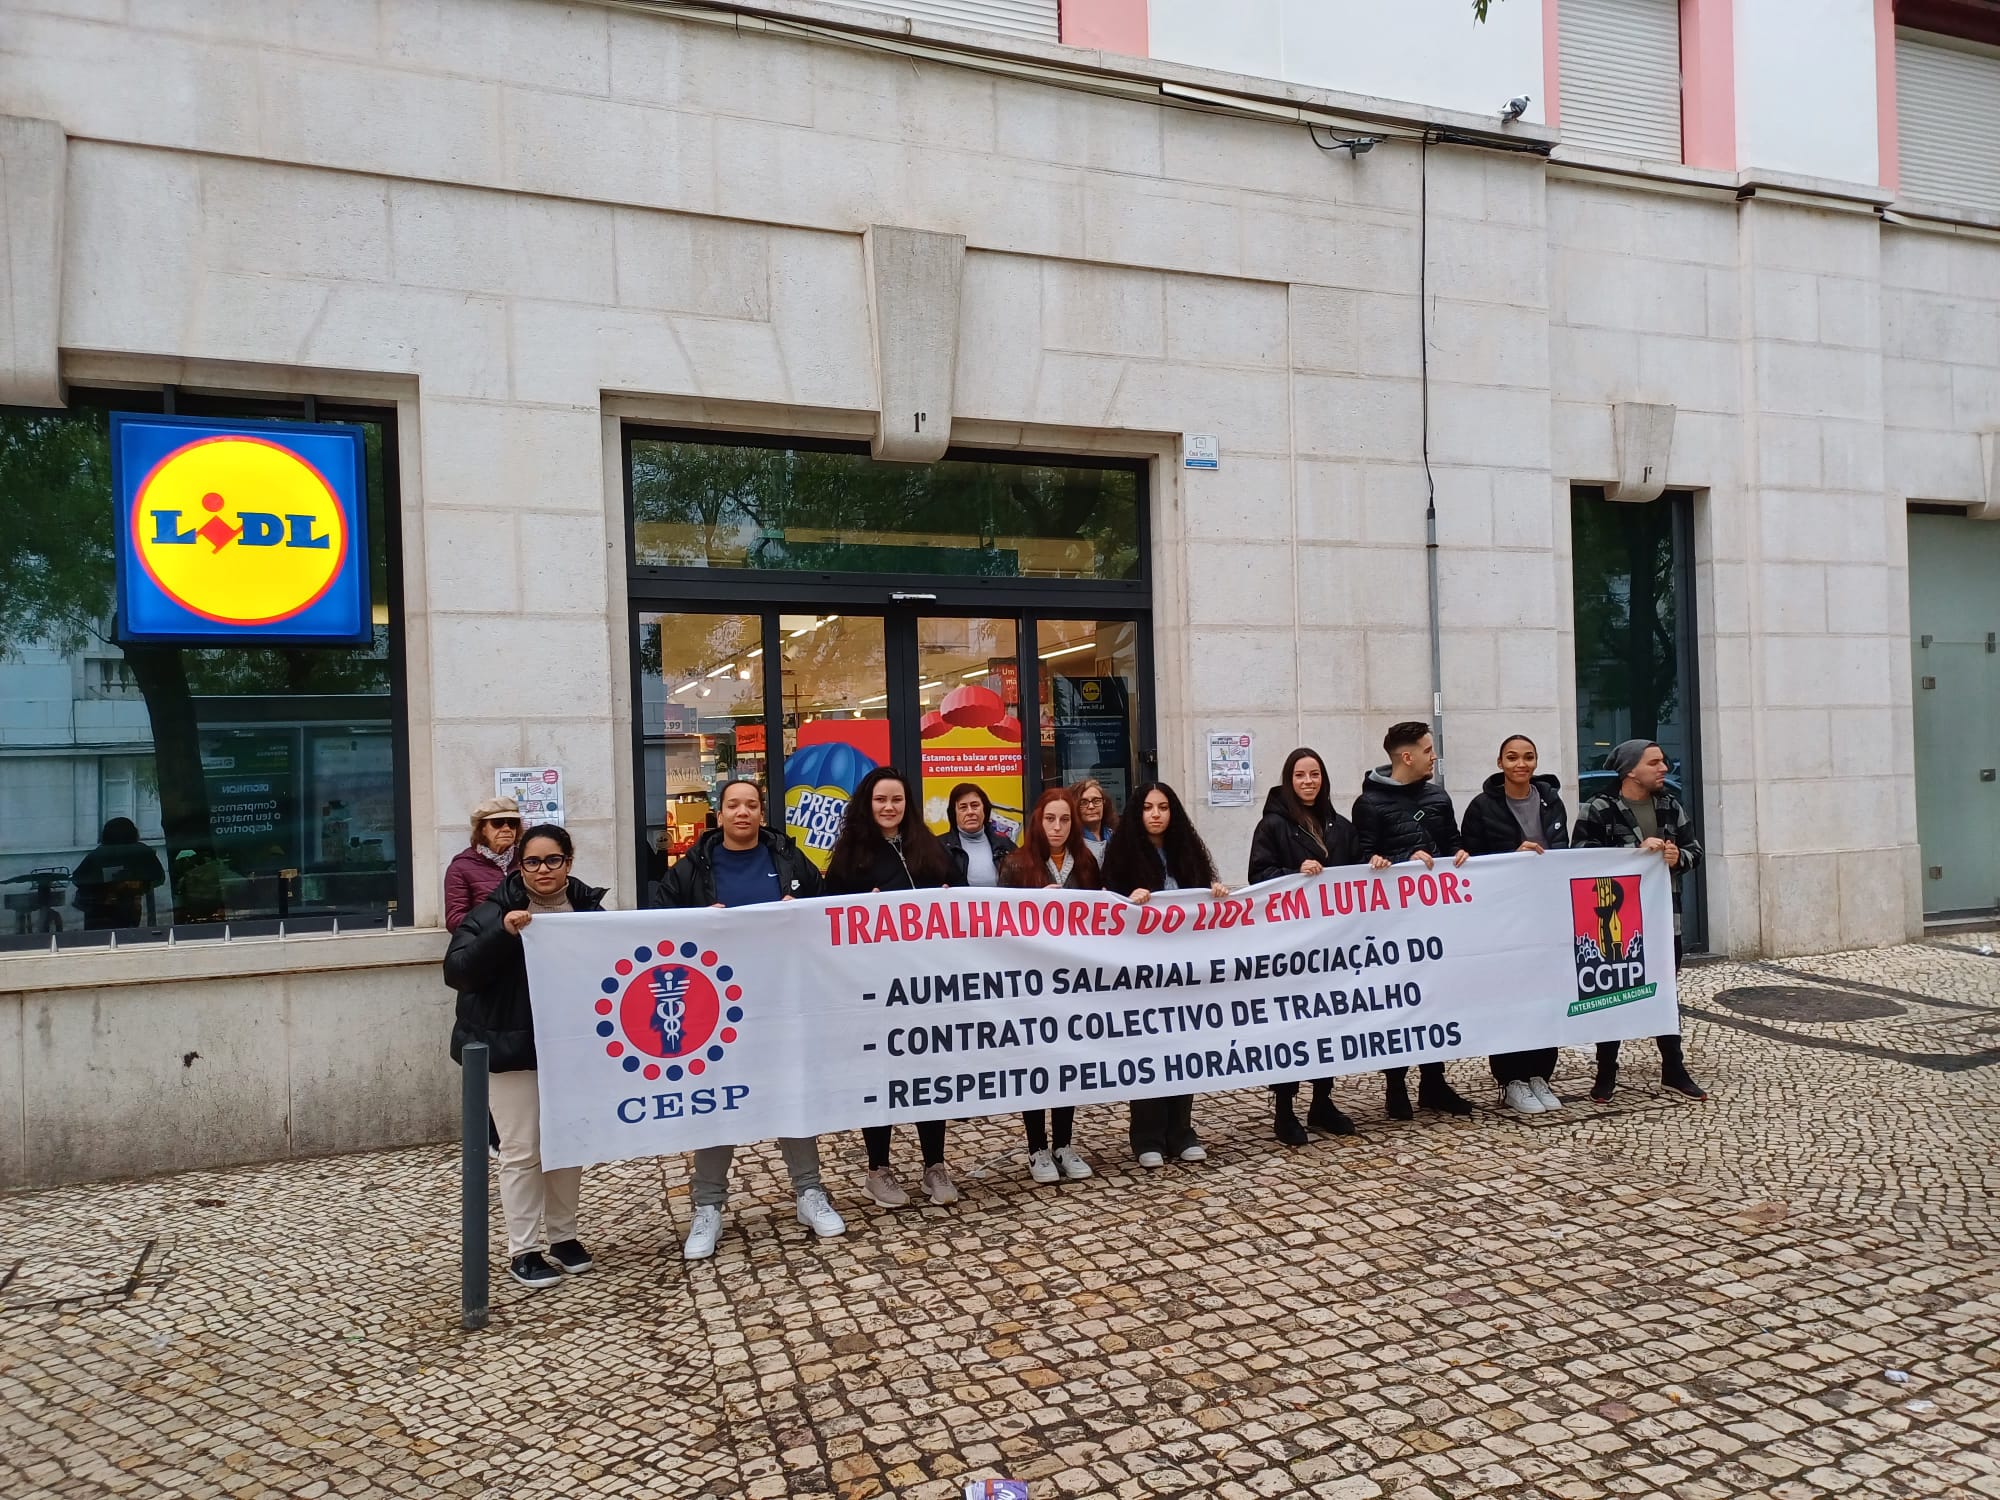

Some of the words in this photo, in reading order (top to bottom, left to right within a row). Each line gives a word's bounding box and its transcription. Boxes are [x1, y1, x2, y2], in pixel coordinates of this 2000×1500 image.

[936, 764, 972, 772] centenas
[975, 763, 985, 771] de
[987, 764, 1017, 773] artigos!
[963, 753, 987, 761] baixar
[785, 806, 811, 828] EM
[825, 900, 1127, 946] TRABALHADORES
[1137, 904, 1185, 935] DO
[1192, 897, 1255, 931] LIDL
[1265, 888, 1311, 923] EM
[1319, 878, 1390, 917] LUTA
[1398, 872, 1473, 909] POR:
[885, 969, 1043, 1007] AUMENTO
[1052, 961, 1201, 995] SALARIAL
[1210, 959, 1225, 984] E
[1234, 935, 1400, 981] NEGOCIAÇÃO
[1407, 936, 1443, 963] DO
[1578, 961, 1644, 993] CGTP
[1571, 995, 1621, 1013] INTERSINDICAL
[1622, 986, 1653, 1000] NACIONAL
[887, 1016, 1058, 1057] CONTRATO
[1067, 1002, 1223, 1041] COLECTIVO
[1231, 998, 1268, 1027] DE
[1274, 981, 1422, 1021] TRABALHO
[888, 1066, 1049, 1109] RESPEITO
[1059, 1057, 1154, 1092] PELOS
[1164, 1039, 1310, 1082] HORÁRIOS
[1317, 1037, 1335, 1065] E
[1341, 1021, 1462, 1060] DIREITOS
[617, 1085, 750, 1124] CESP
